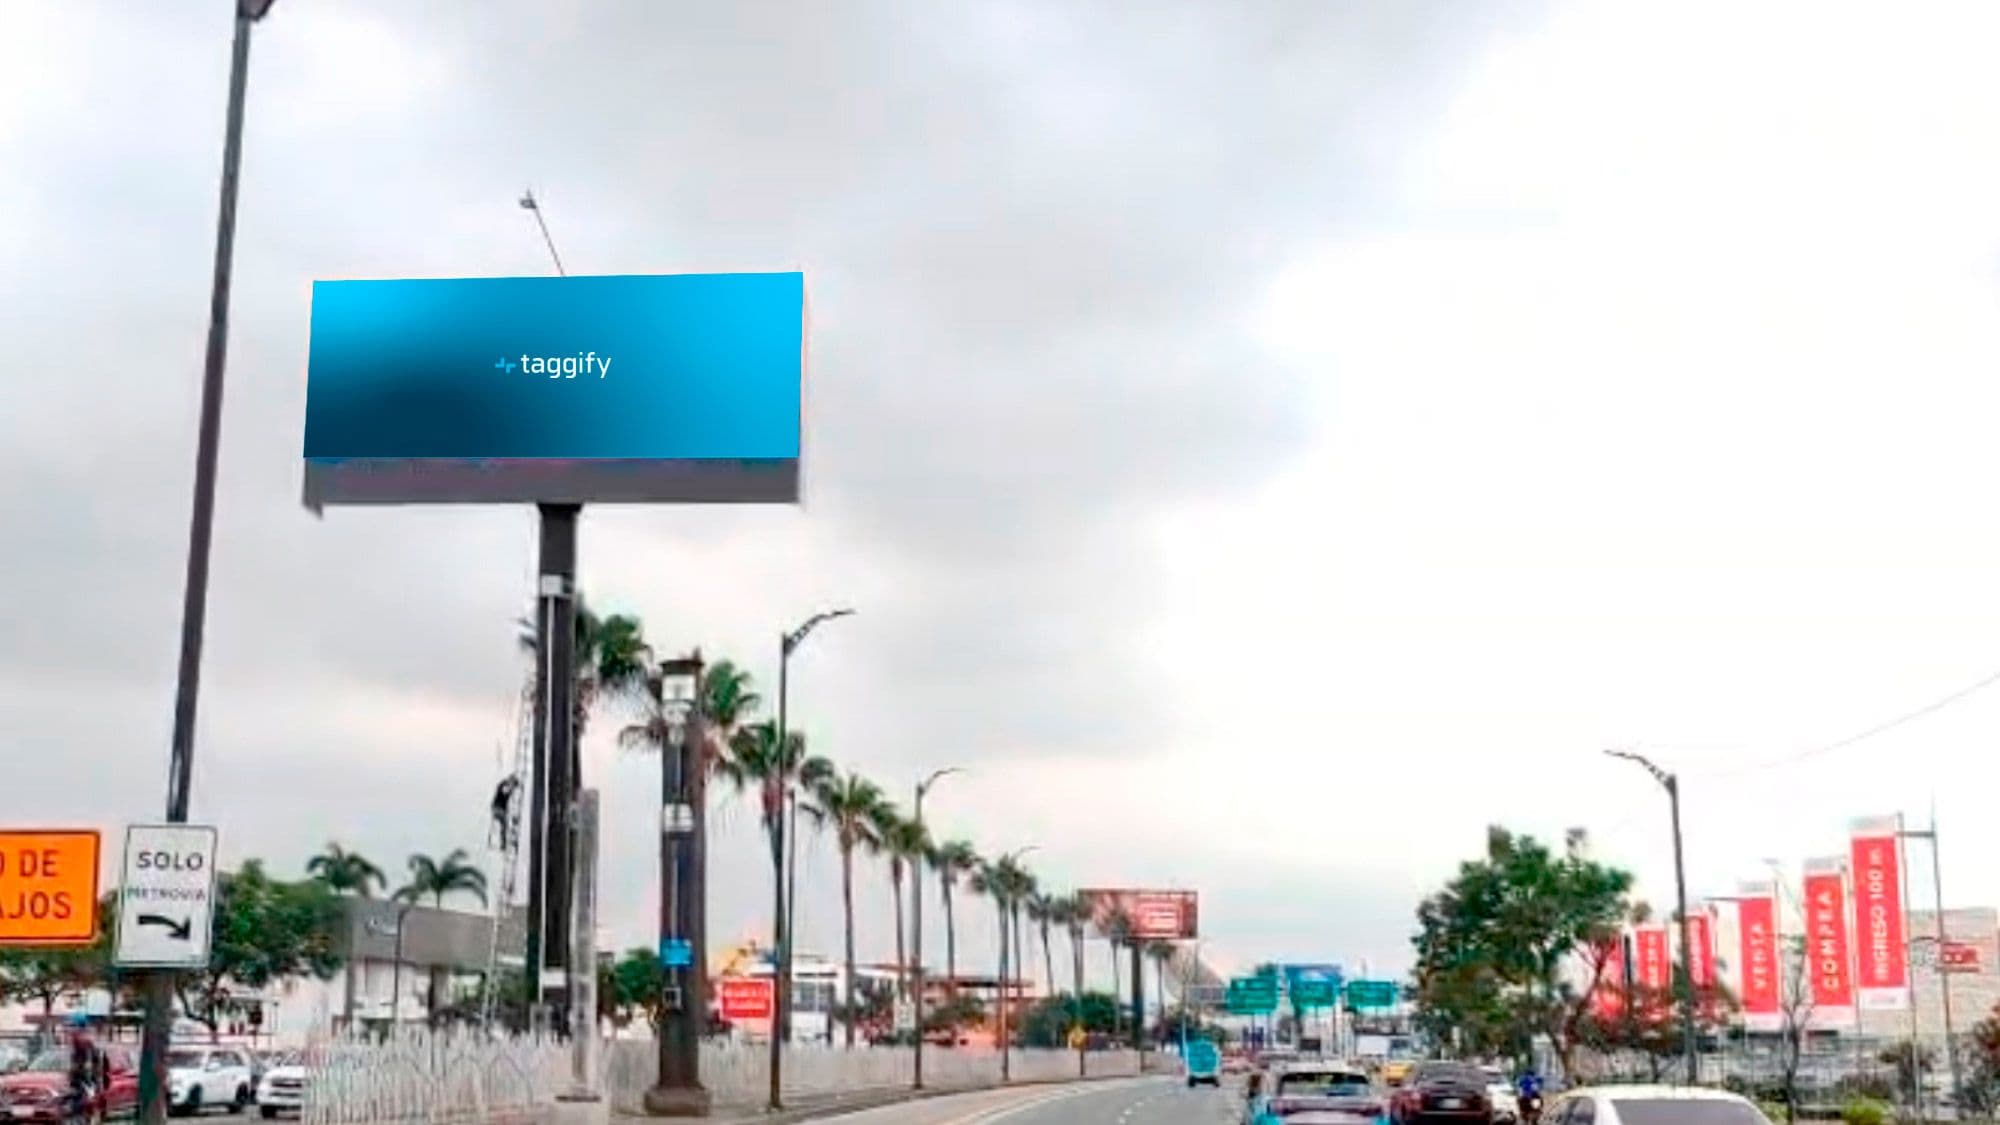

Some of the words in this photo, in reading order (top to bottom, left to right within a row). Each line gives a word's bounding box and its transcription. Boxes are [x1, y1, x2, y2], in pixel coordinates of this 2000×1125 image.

[520, 351, 612, 379] taggify
[19, 848, 60, 877] DE
[137, 851, 203, 871] SOLO
[1867, 863, 1885, 900] 100
[0, 890, 71, 920] JOS
[1816, 891, 1840, 991] COMPRA
